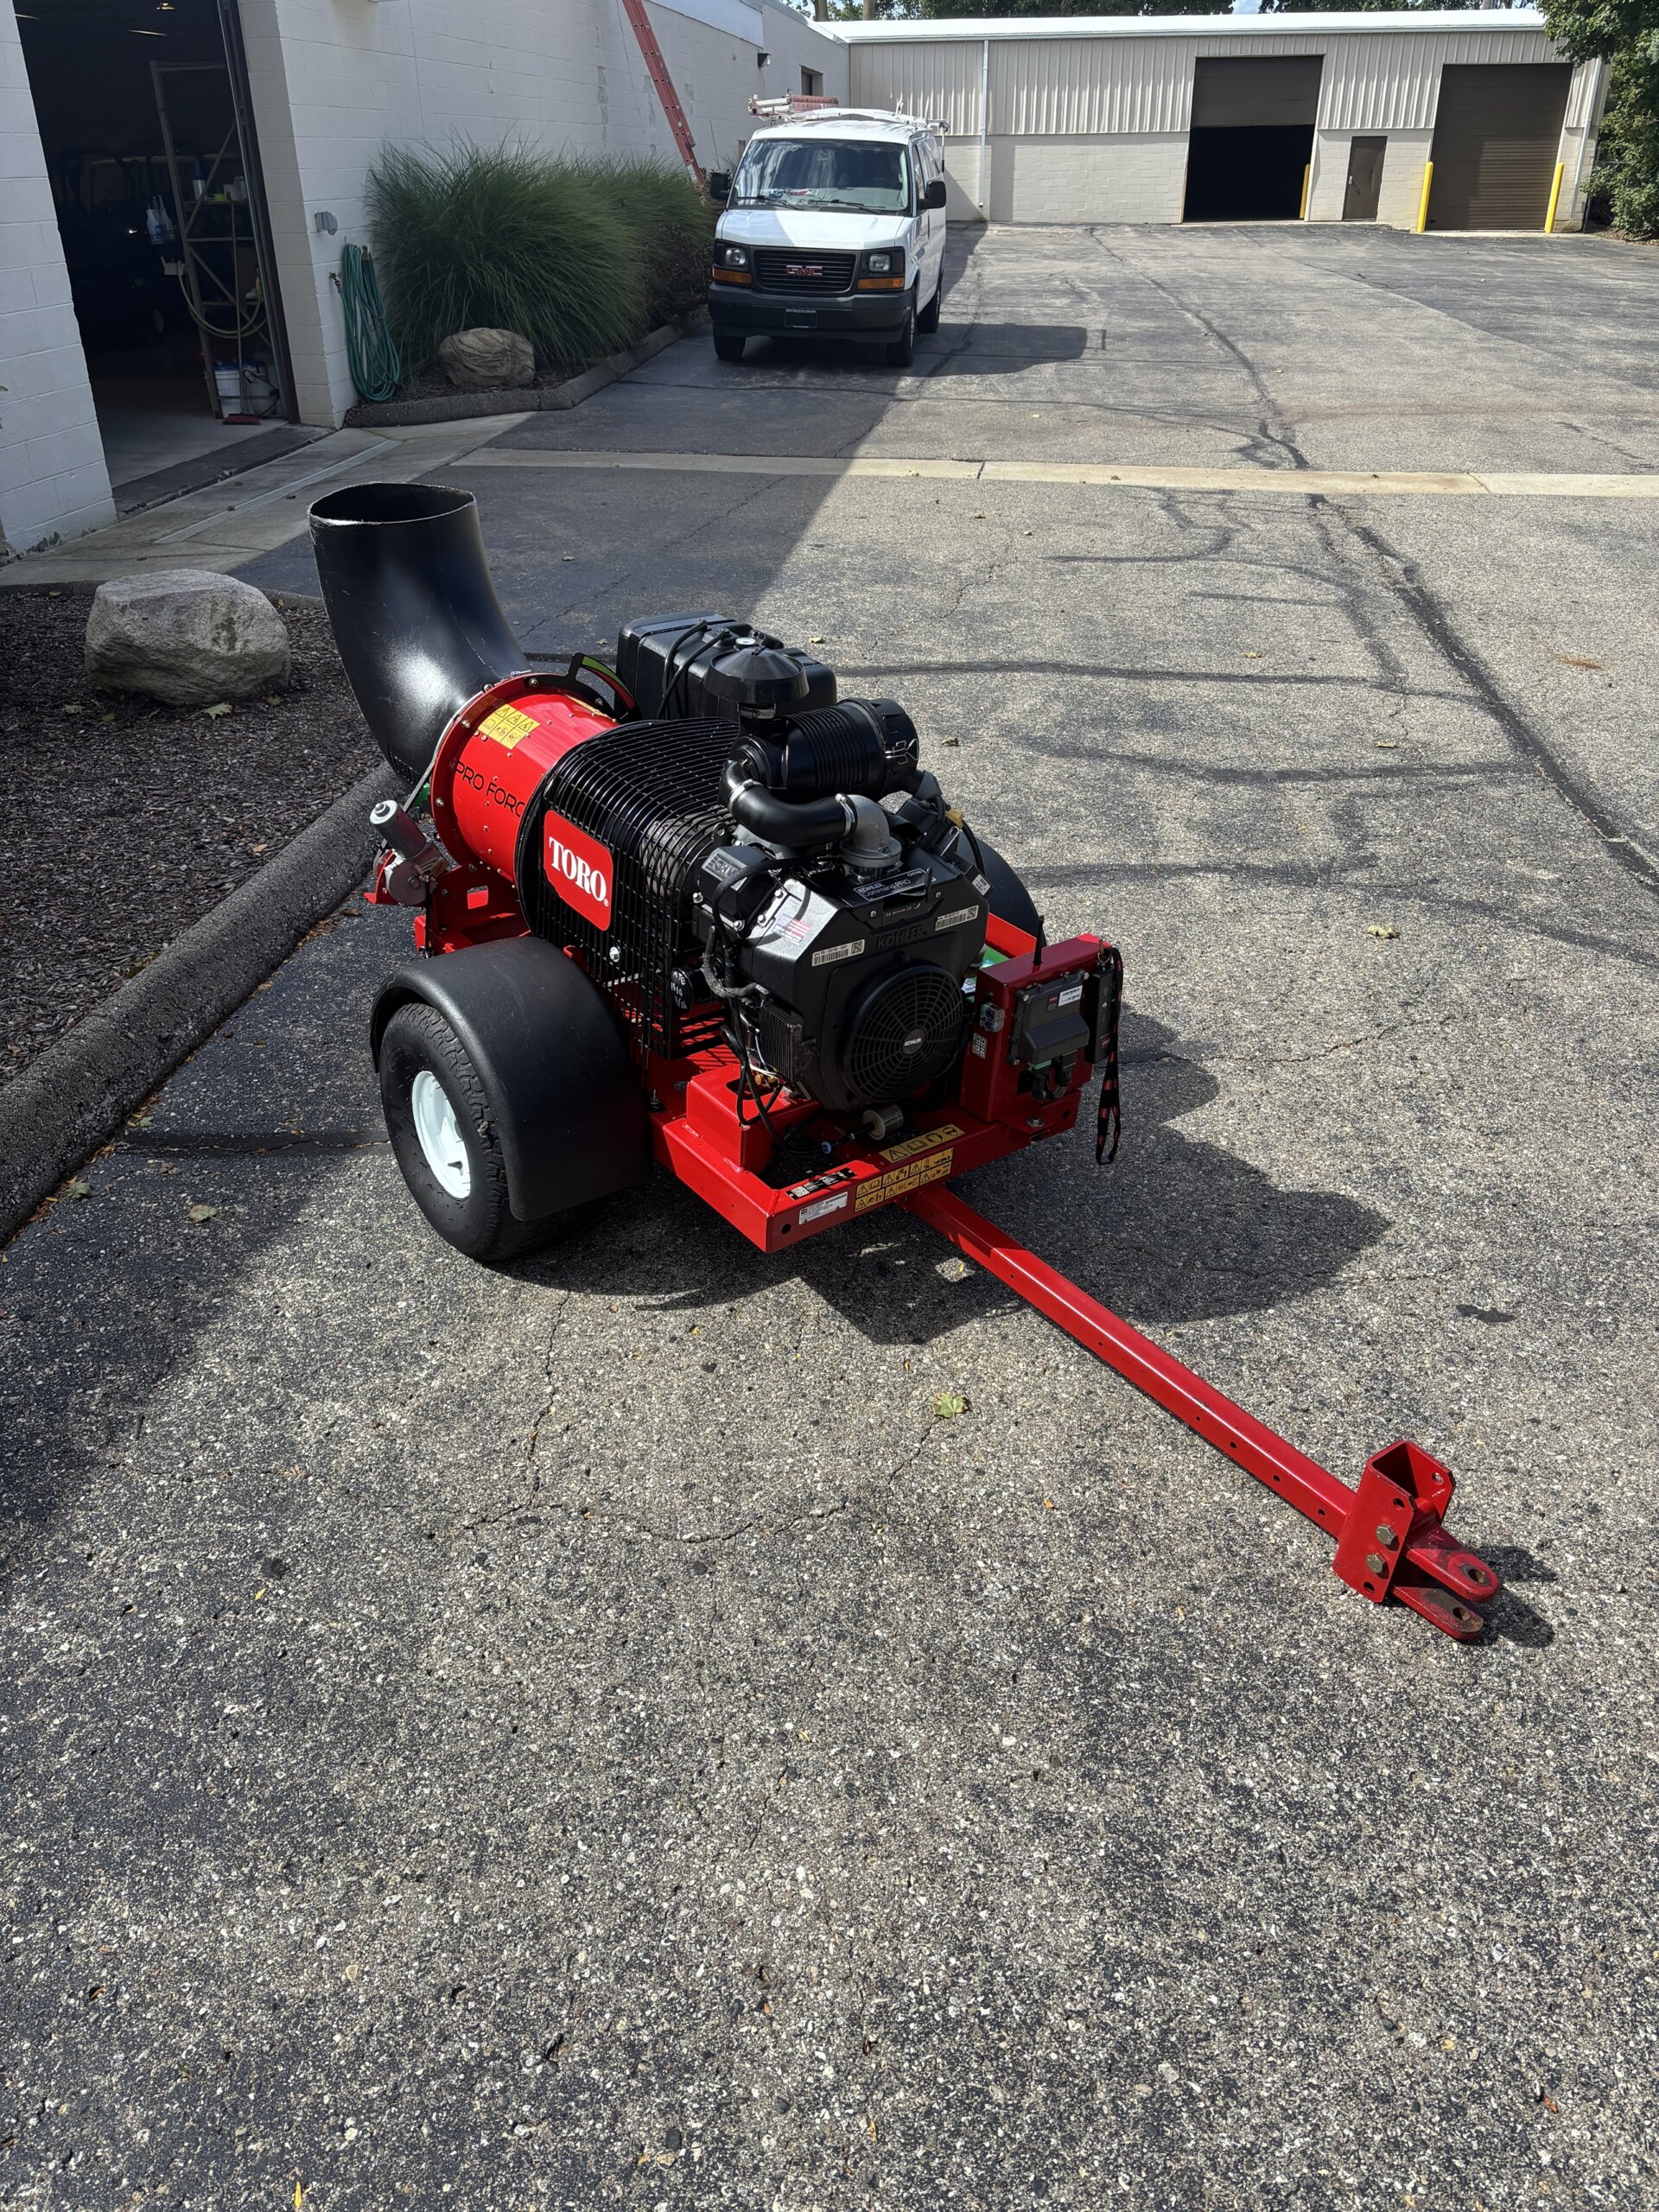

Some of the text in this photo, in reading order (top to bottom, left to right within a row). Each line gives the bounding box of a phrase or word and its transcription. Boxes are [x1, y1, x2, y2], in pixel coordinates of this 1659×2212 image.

[786, 264, 823, 276] GMC
[455, 760, 525, 817] PRO FORC
[549, 836, 607, 903] TORO
